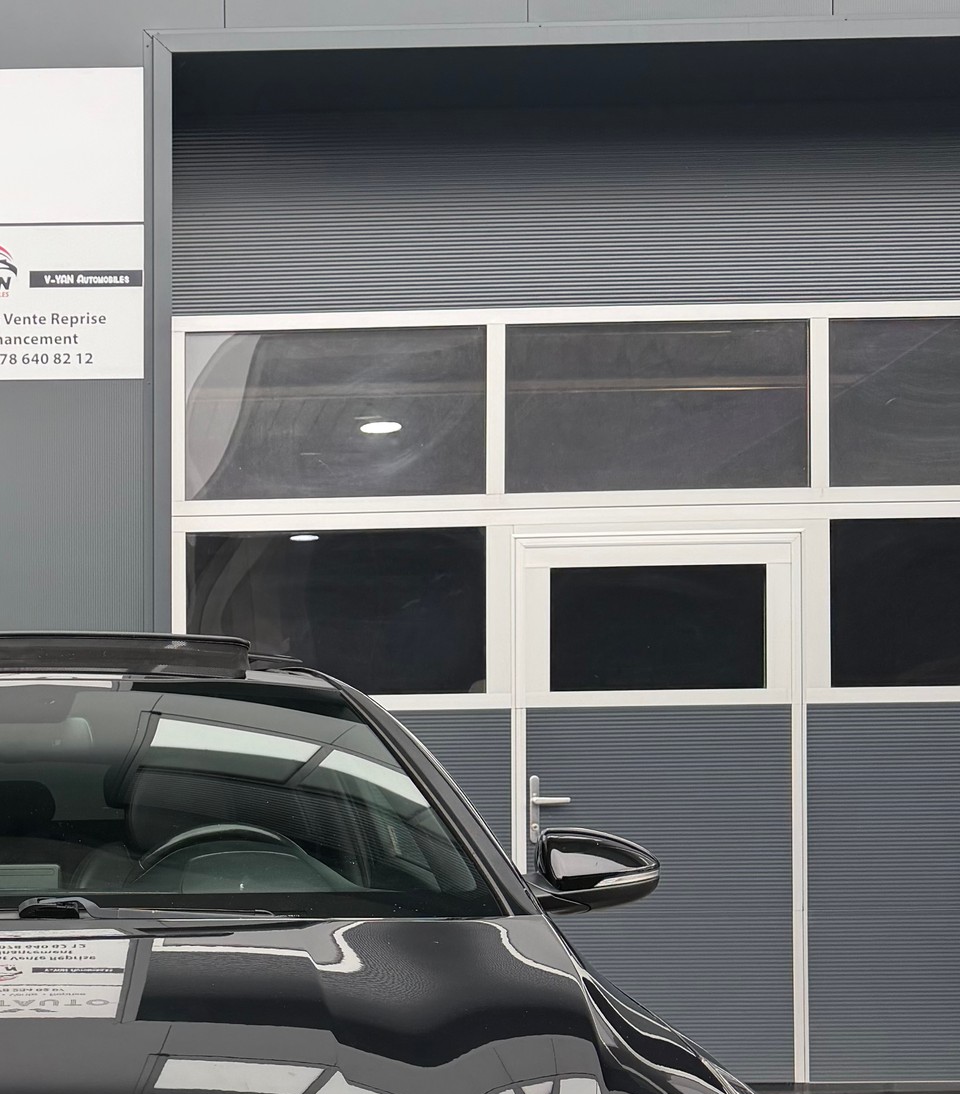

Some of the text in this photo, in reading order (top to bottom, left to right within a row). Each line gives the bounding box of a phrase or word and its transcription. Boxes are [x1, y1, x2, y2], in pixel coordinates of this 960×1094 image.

[44, 274, 74, 284] V-YAN
[3, 313, 47, 326] Vente
[50, 312, 107, 328] Reprise
[21, 353, 49, 365] 640
[53, 352, 72, 365] 82
[77, 352, 94, 365] 12
